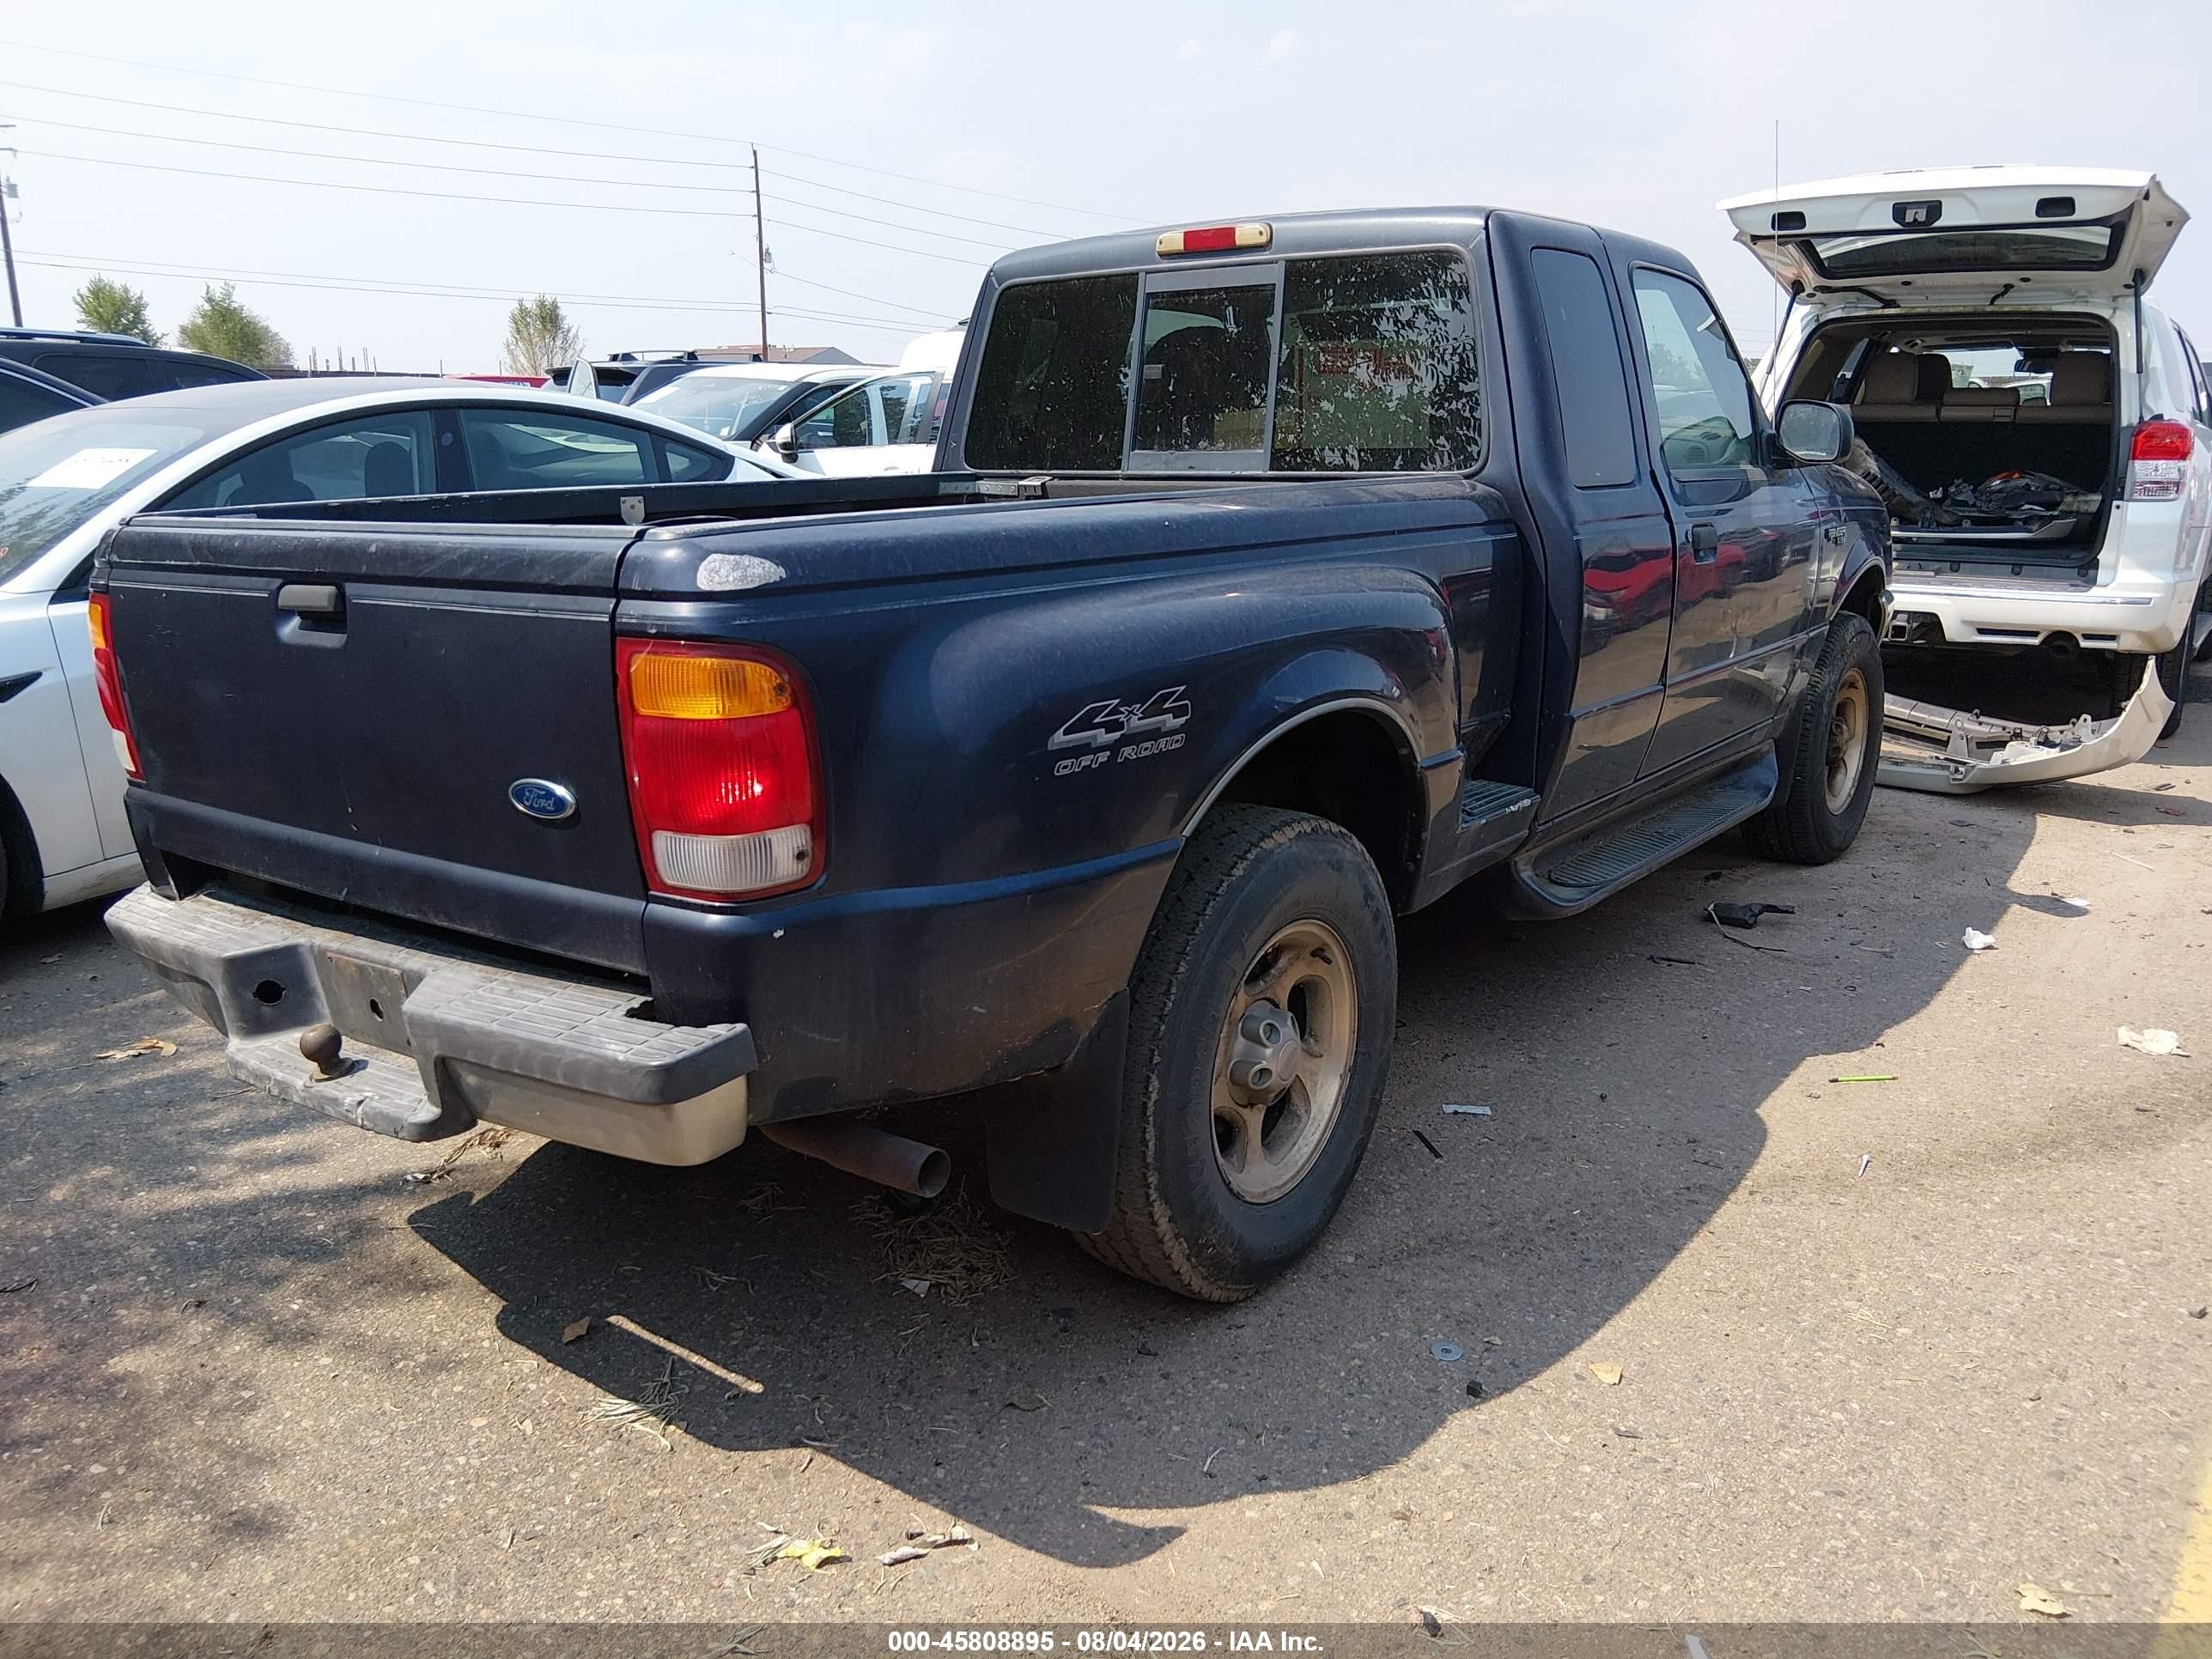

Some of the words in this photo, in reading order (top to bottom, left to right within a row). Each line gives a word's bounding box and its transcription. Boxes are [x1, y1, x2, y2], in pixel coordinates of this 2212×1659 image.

[1054, 750, 1110, 775] OFF
[1117, 733, 1186, 763] ROAD
[522, 787, 556, 811] Ford
